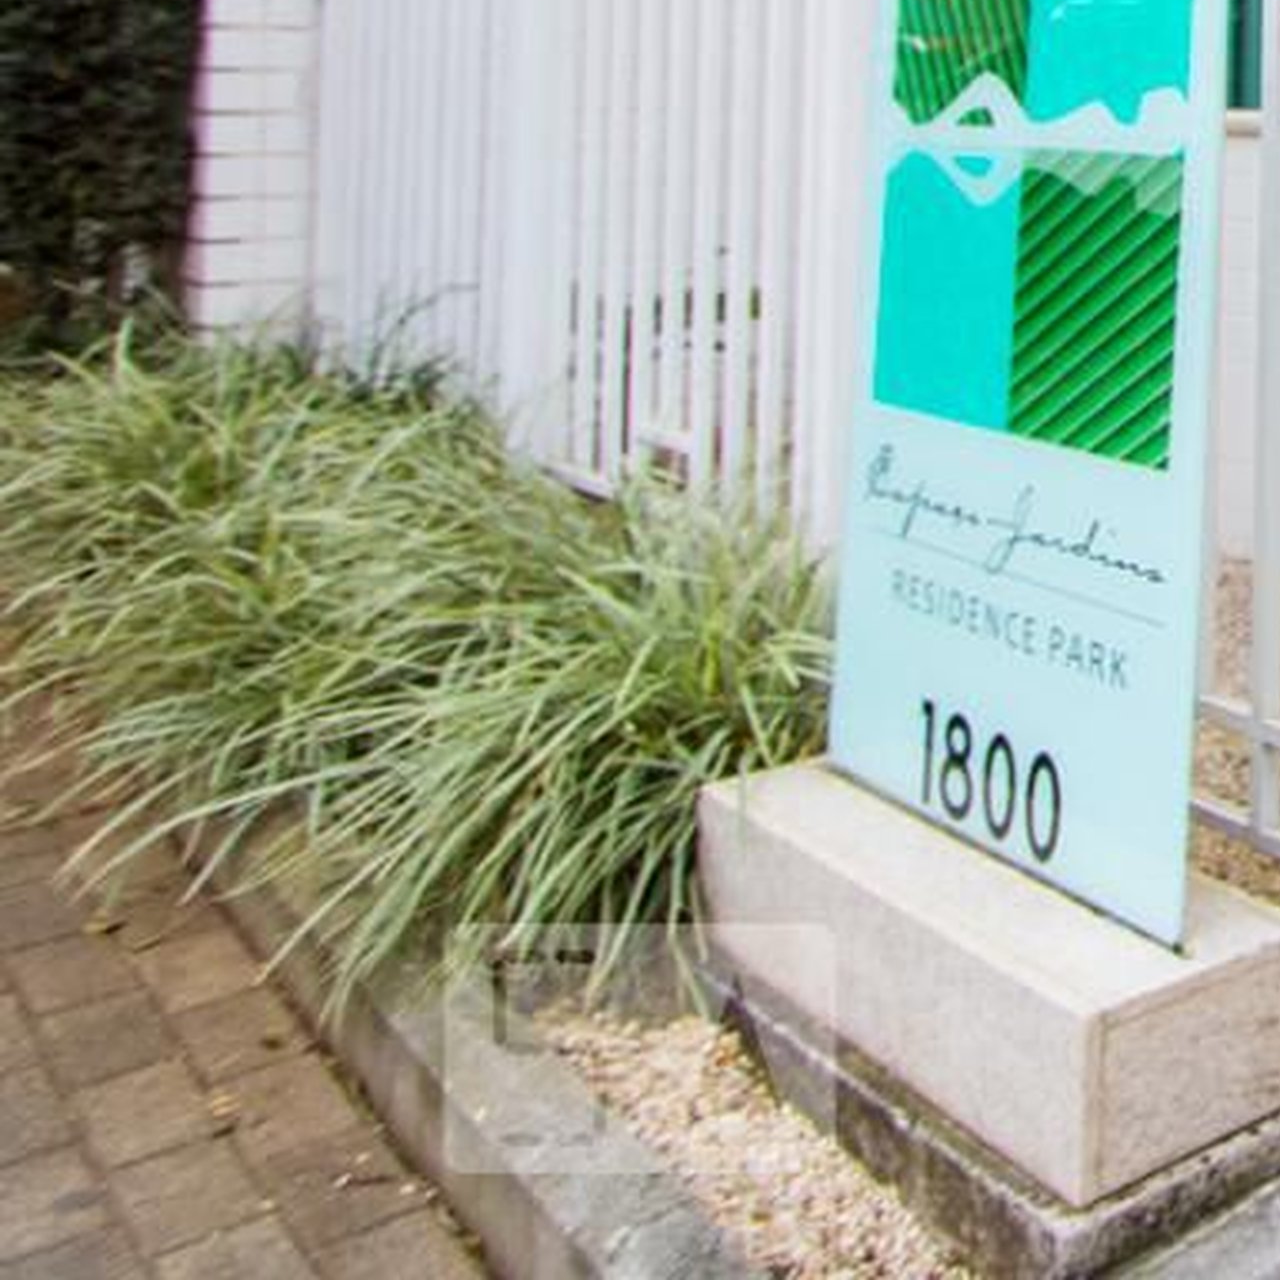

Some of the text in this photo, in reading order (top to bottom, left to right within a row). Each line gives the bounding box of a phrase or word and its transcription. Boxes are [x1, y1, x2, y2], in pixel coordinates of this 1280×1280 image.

[892, 568, 1128, 689] RESIDENCE PARK
[921, 698, 1062, 863] 1800
